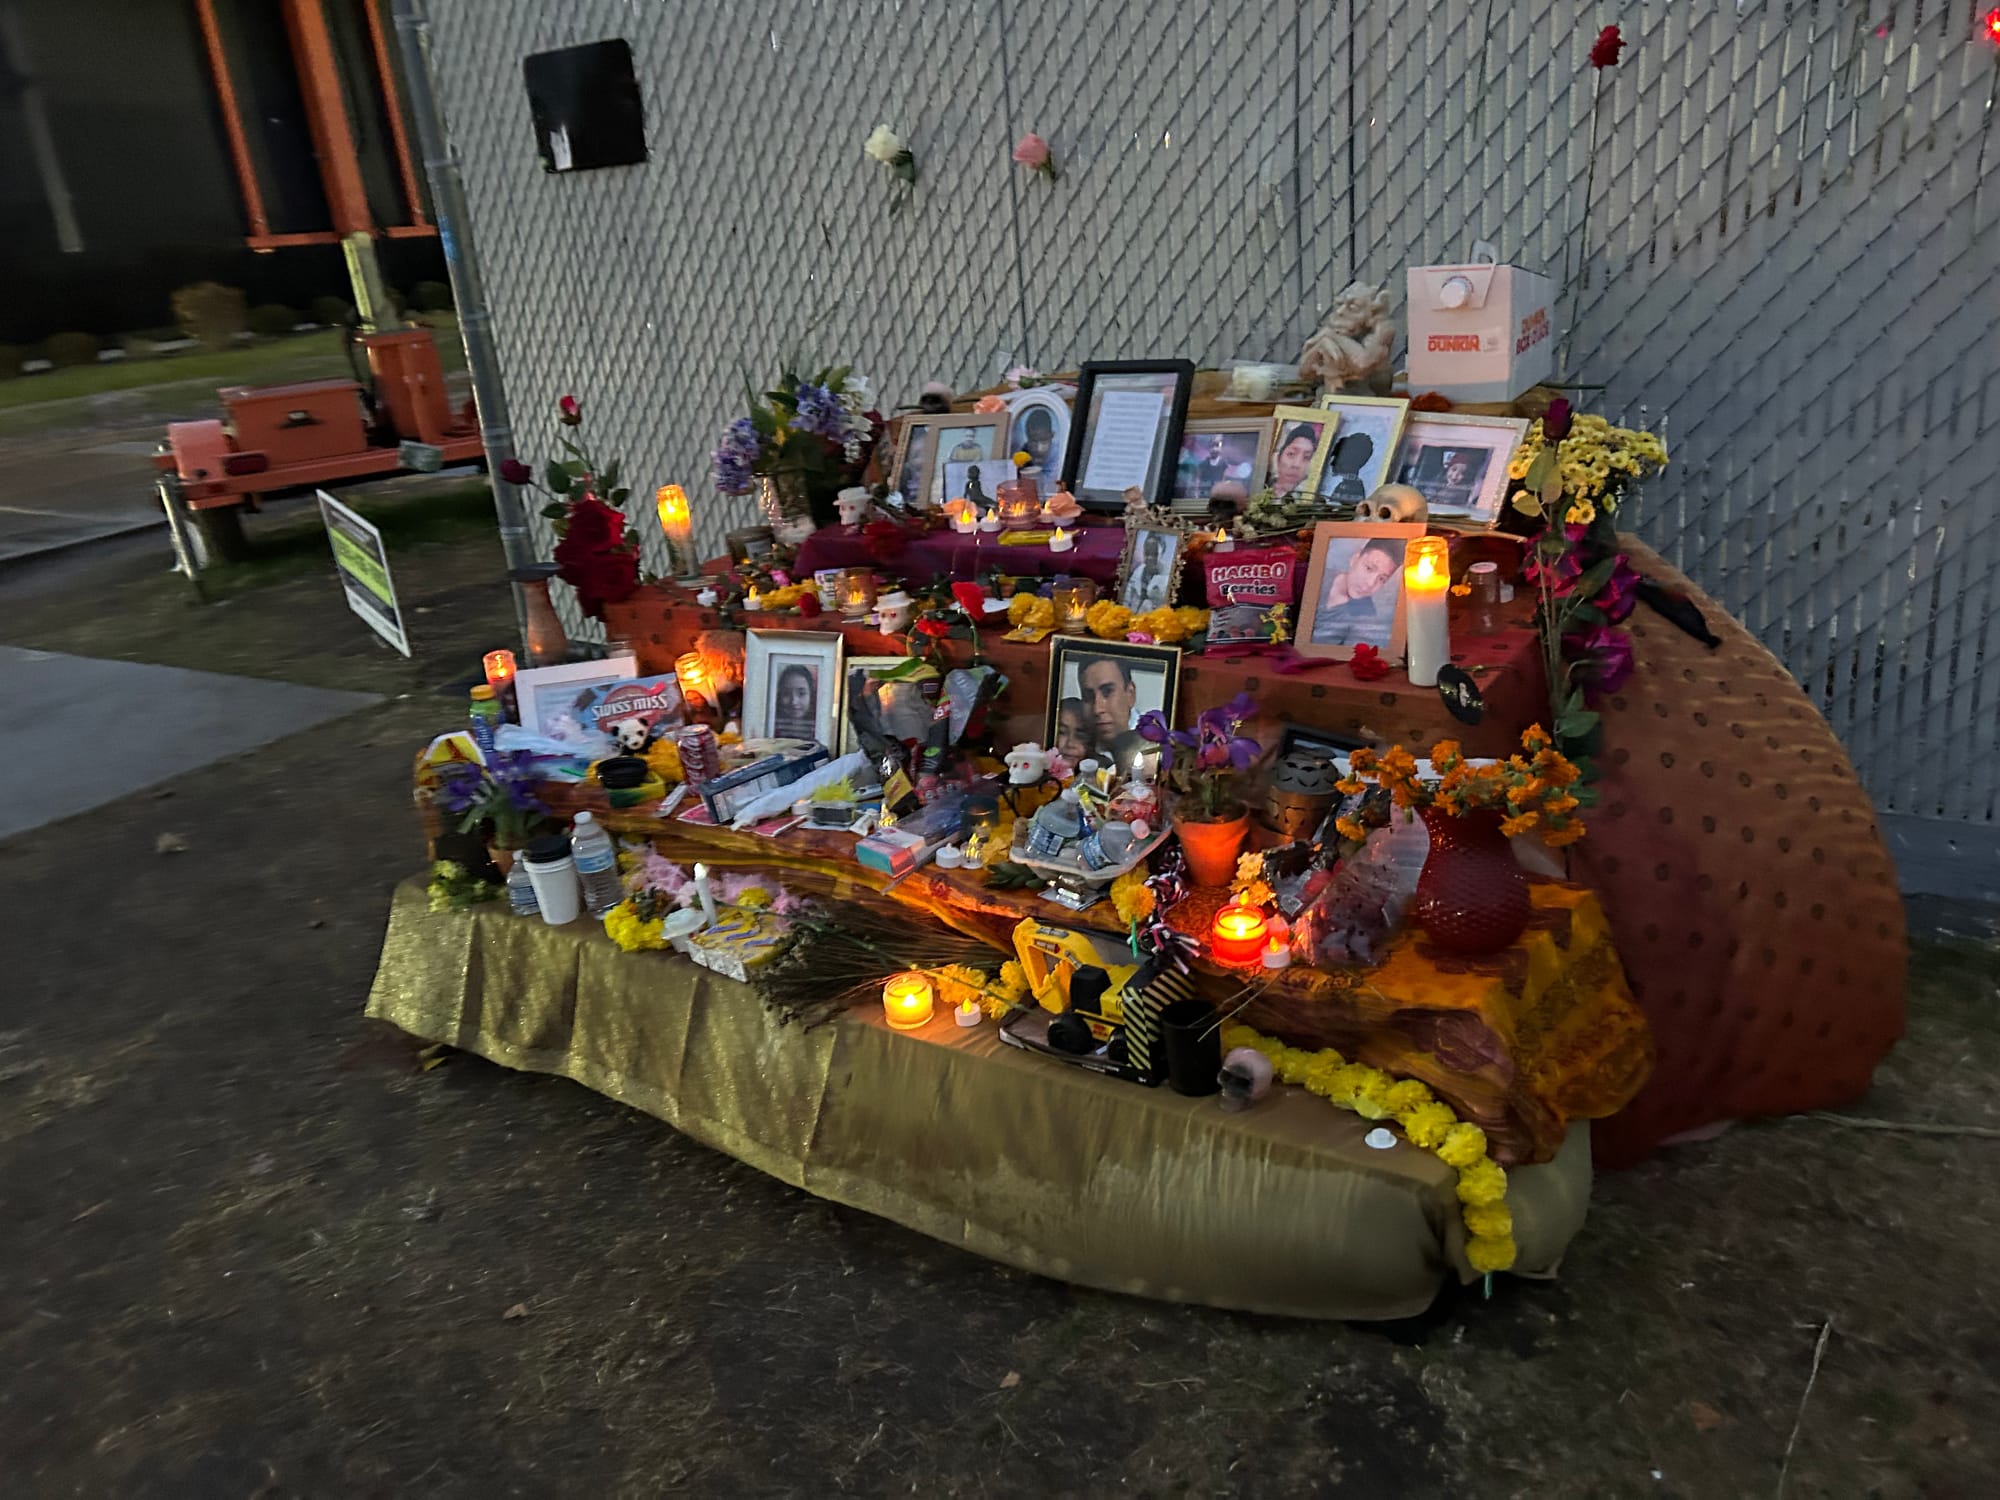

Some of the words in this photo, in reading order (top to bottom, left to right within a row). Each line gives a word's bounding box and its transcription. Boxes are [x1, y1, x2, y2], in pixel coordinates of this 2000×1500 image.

[1211, 562, 1287, 583] HARIBO
[1220, 580, 1276, 595] Berries
[591, 701, 632, 721] SWISS
[633, 694, 668, 710] MISS
